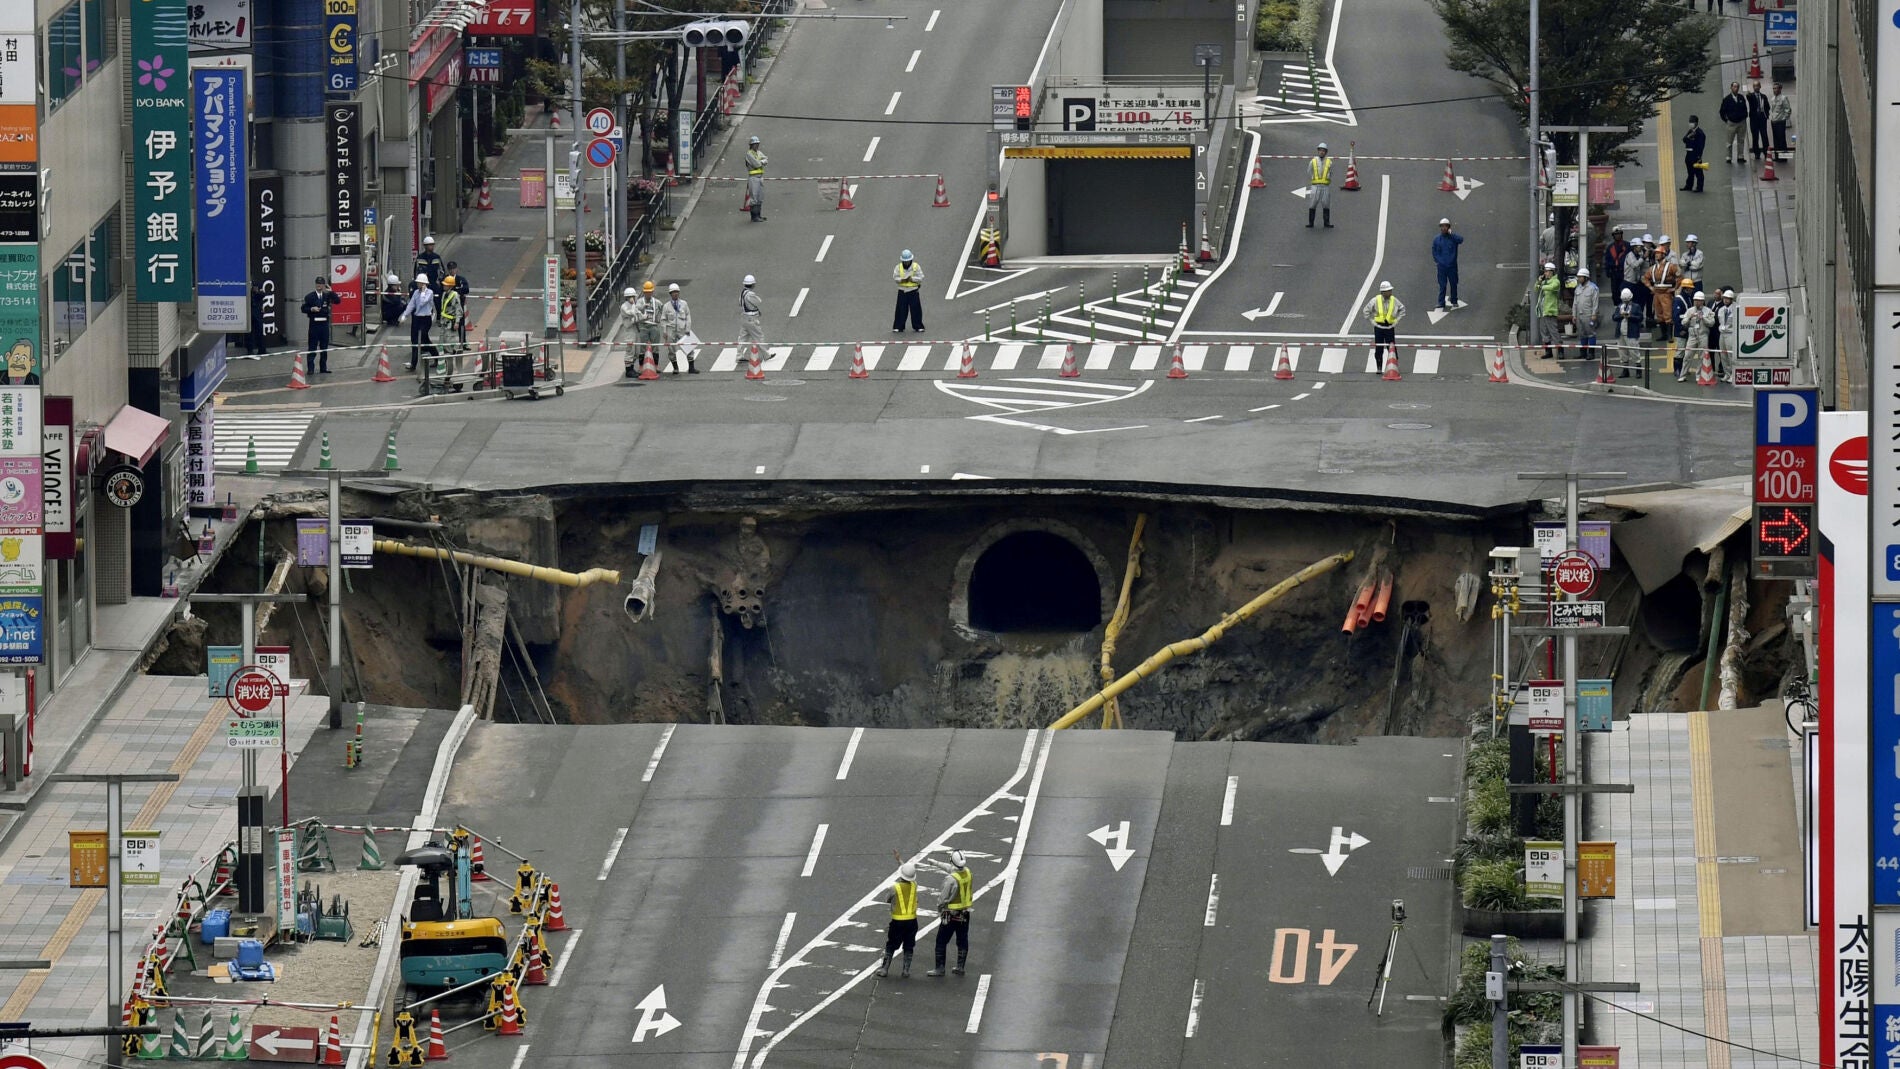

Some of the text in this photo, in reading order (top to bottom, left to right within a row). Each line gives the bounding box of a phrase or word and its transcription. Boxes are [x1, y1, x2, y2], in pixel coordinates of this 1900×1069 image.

[329, 1, 355, 13] 100円
[1769, 13, 1783, 28] P
[189, 21, 235, 37] ホルモン
[6, 38, 17, 61] 村田
[331, 74, 353, 89] 6F
[469, 68, 499, 81] ATM
[136, 98, 185, 107] IYO BANK
[593, 117, 609, 129] 40
[1069, 104, 1091, 131] P
[0, 134, 33, 142] AZON
[204, 77, 226, 217] アパマンショップ
[229, 119, 237, 184] Communication
[336, 125, 352, 168] CAFÉ
[1197, 146, 1205, 156] P
[338, 172, 349, 185] de
[1197, 172, 1205, 189] 入口
[145, 129, 179, 284] 伊予銀行
[261, 189, 276, 250] CAFÉ
[262, 256, 274, 274] de
[1757, 371, 1768, 383] 酒
[1773, 371, 1790, 382] ATM
[2, 393, 13, 449] 若者未来塾
[1767, 393, 1808, 443] P
[1766, 450, 1806, 468] 20分
[1758, 471, 1814, 499] 100円
[27, 511, 38, 520] 3F
[1559, 568, 1590, 583] 消火栓
[1554, 604, 1603, 616] とみや歯科
[238, 684, 271, 700] 消火栓
[240, 721, 279, 729] むらつ歯科
[1876, 856, 1900, 870] 44
[1268, 928, 1358, 985] 40
